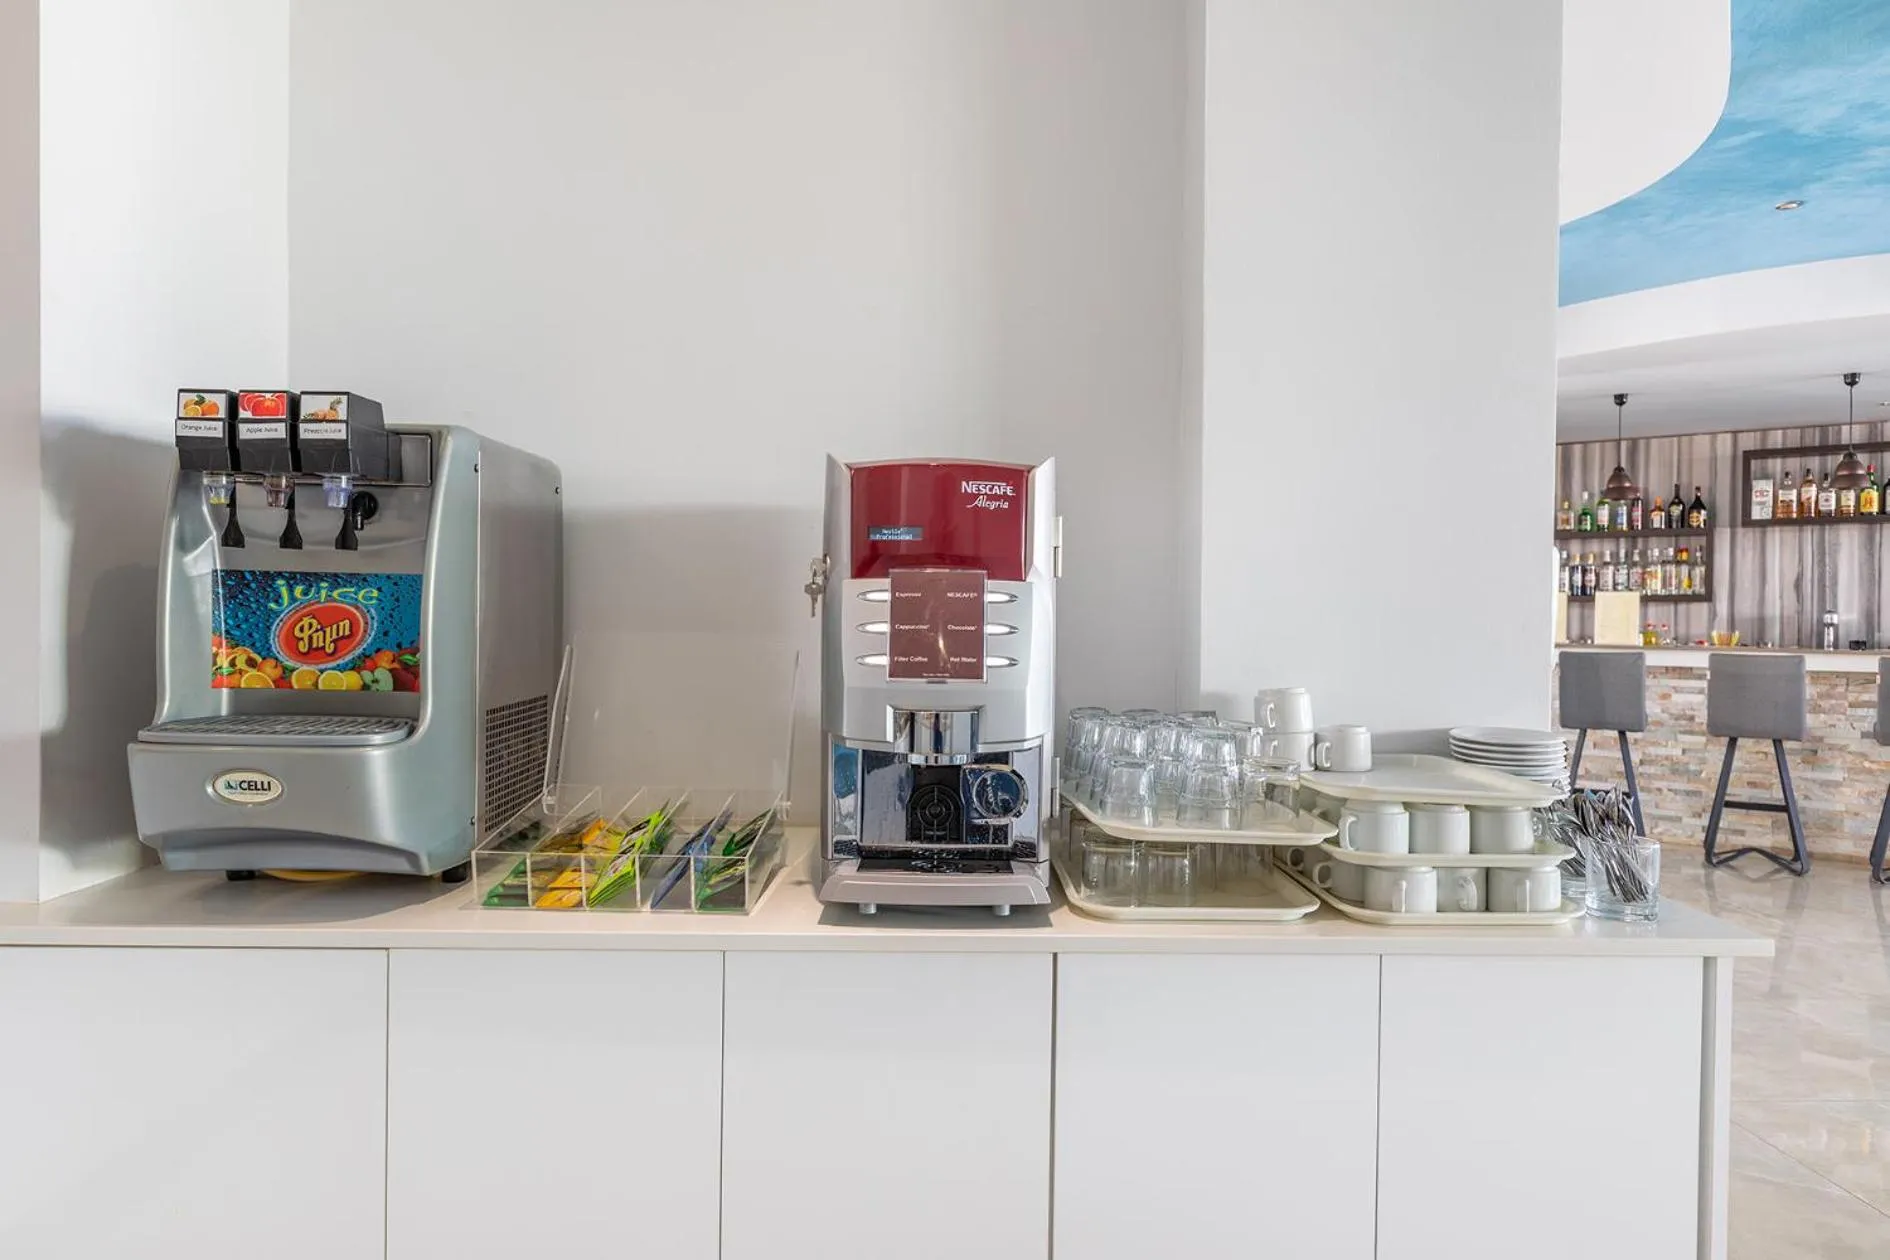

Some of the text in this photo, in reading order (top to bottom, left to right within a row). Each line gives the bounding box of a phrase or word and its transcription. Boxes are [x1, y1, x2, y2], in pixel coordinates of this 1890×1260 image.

[181, 423, 202, 432] Orange
[246, 426, 262, 434] Apple
[966, 494, 1009, 510] Alegria
[239, 780, 272, 792] CELLI
